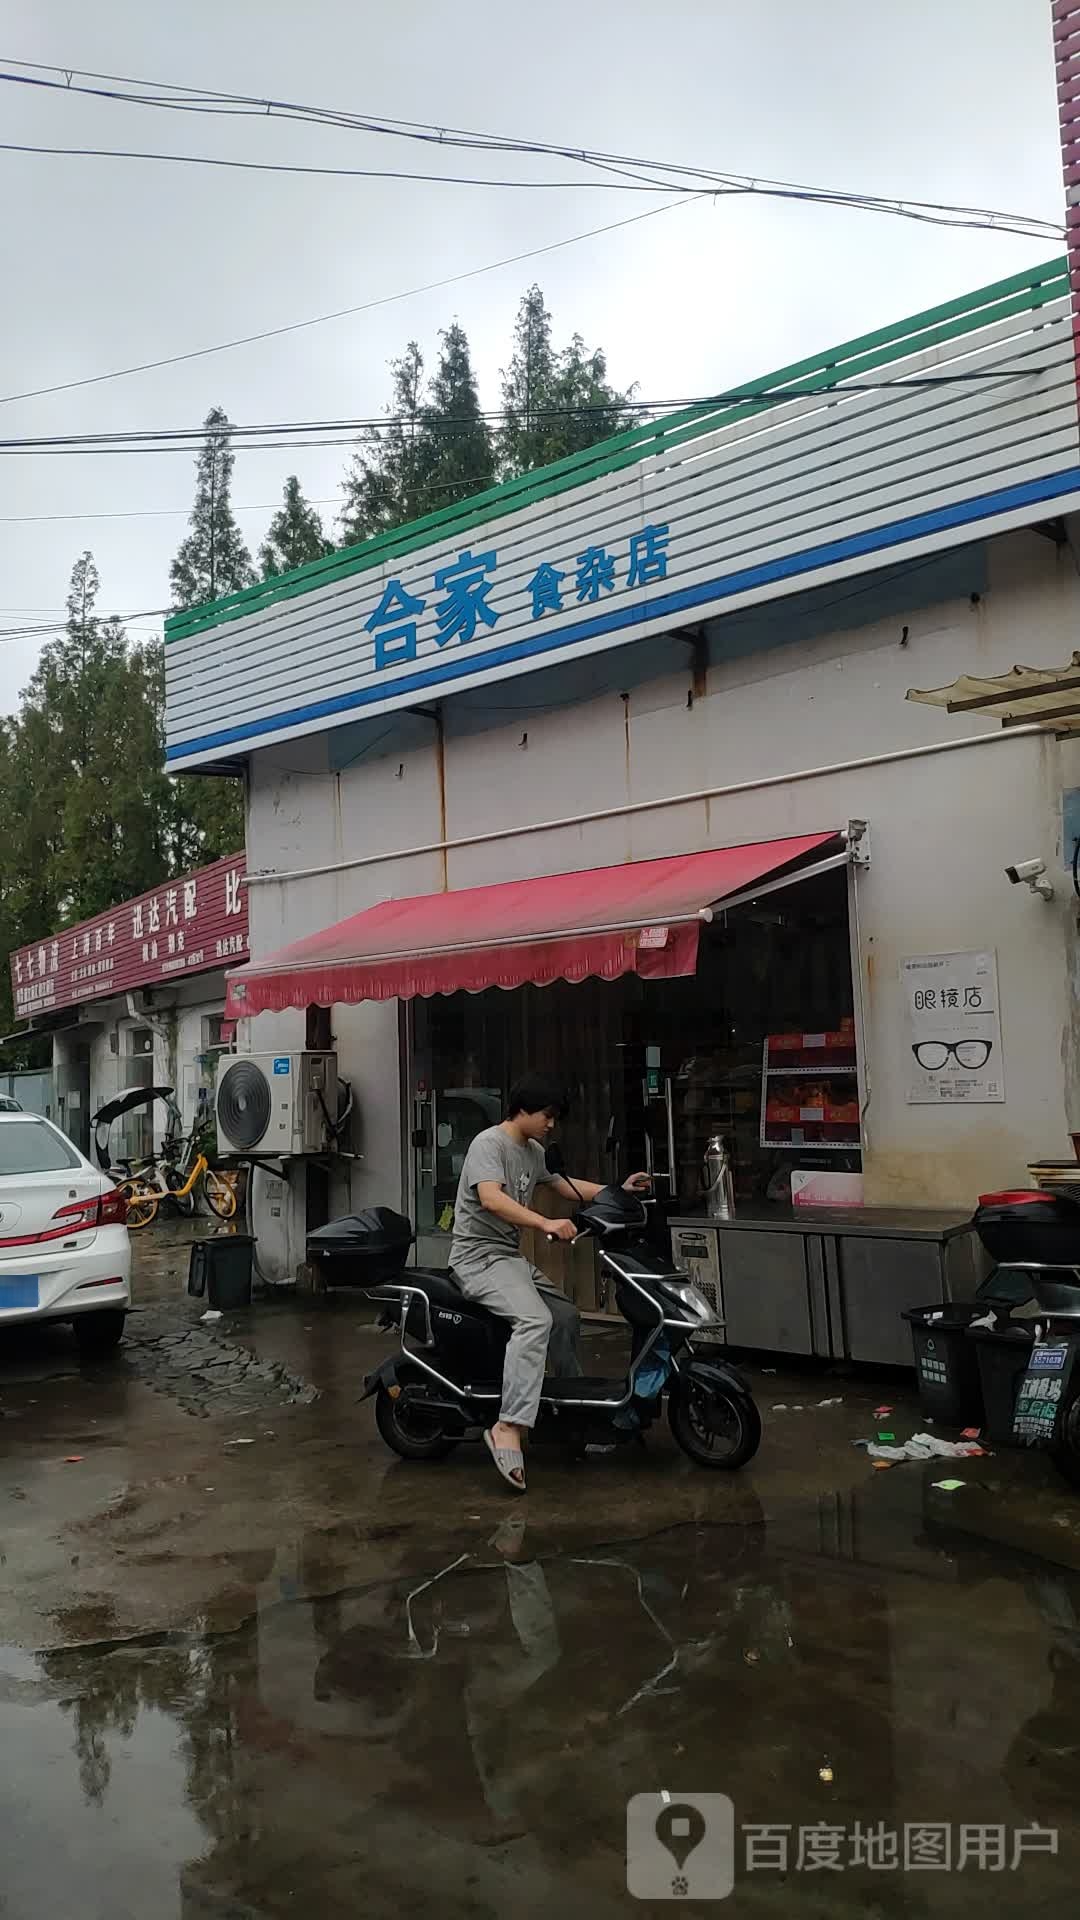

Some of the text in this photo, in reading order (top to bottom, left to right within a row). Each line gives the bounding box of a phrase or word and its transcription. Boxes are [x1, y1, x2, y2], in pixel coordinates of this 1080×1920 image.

[364, 524, 670, 671] 合家 食杂店
[132, 879, 198, 939] 迅达汽配
[914, 986, 983, 1010] 眼镜店
